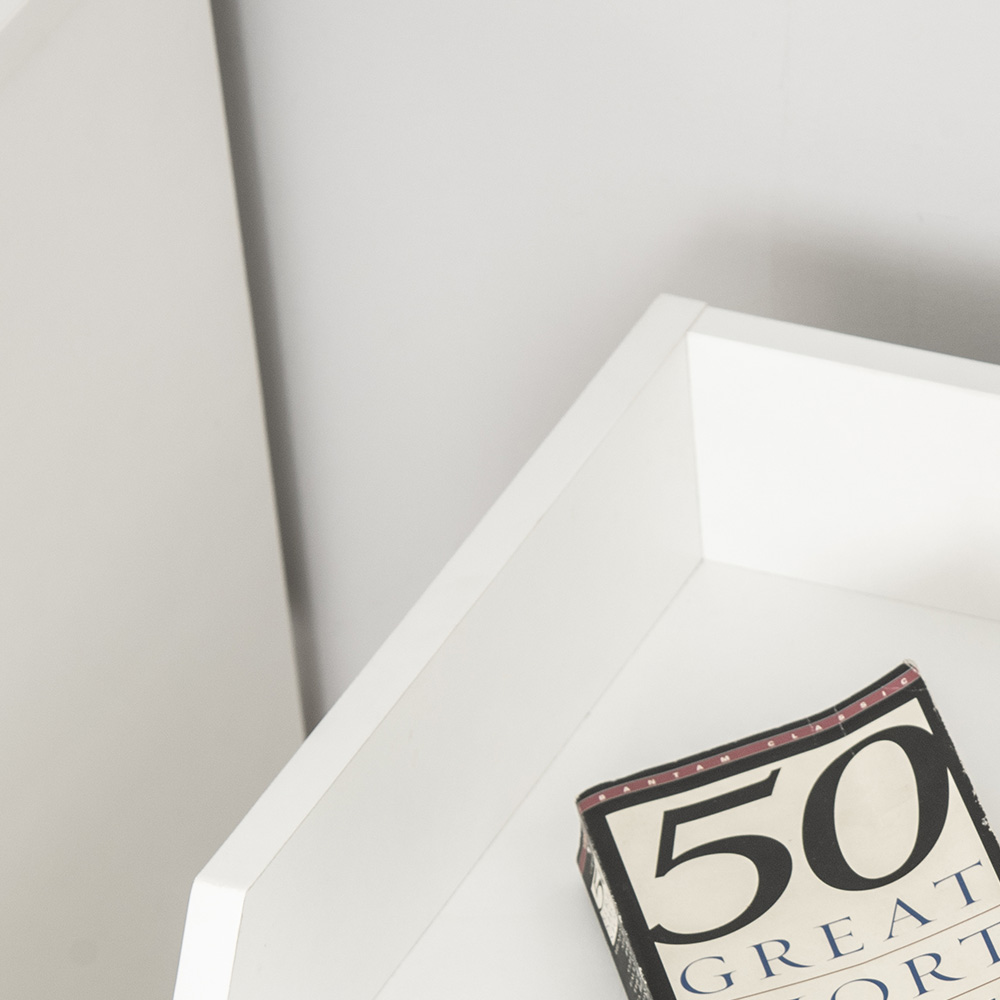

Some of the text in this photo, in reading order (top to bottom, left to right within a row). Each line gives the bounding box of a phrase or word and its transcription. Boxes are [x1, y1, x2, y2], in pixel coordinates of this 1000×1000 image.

[597, 675, 909, 803] BANTAM CLASSIC
[651, 724, 953, 946] 50
[679, 860, 984, 995] GREAT
